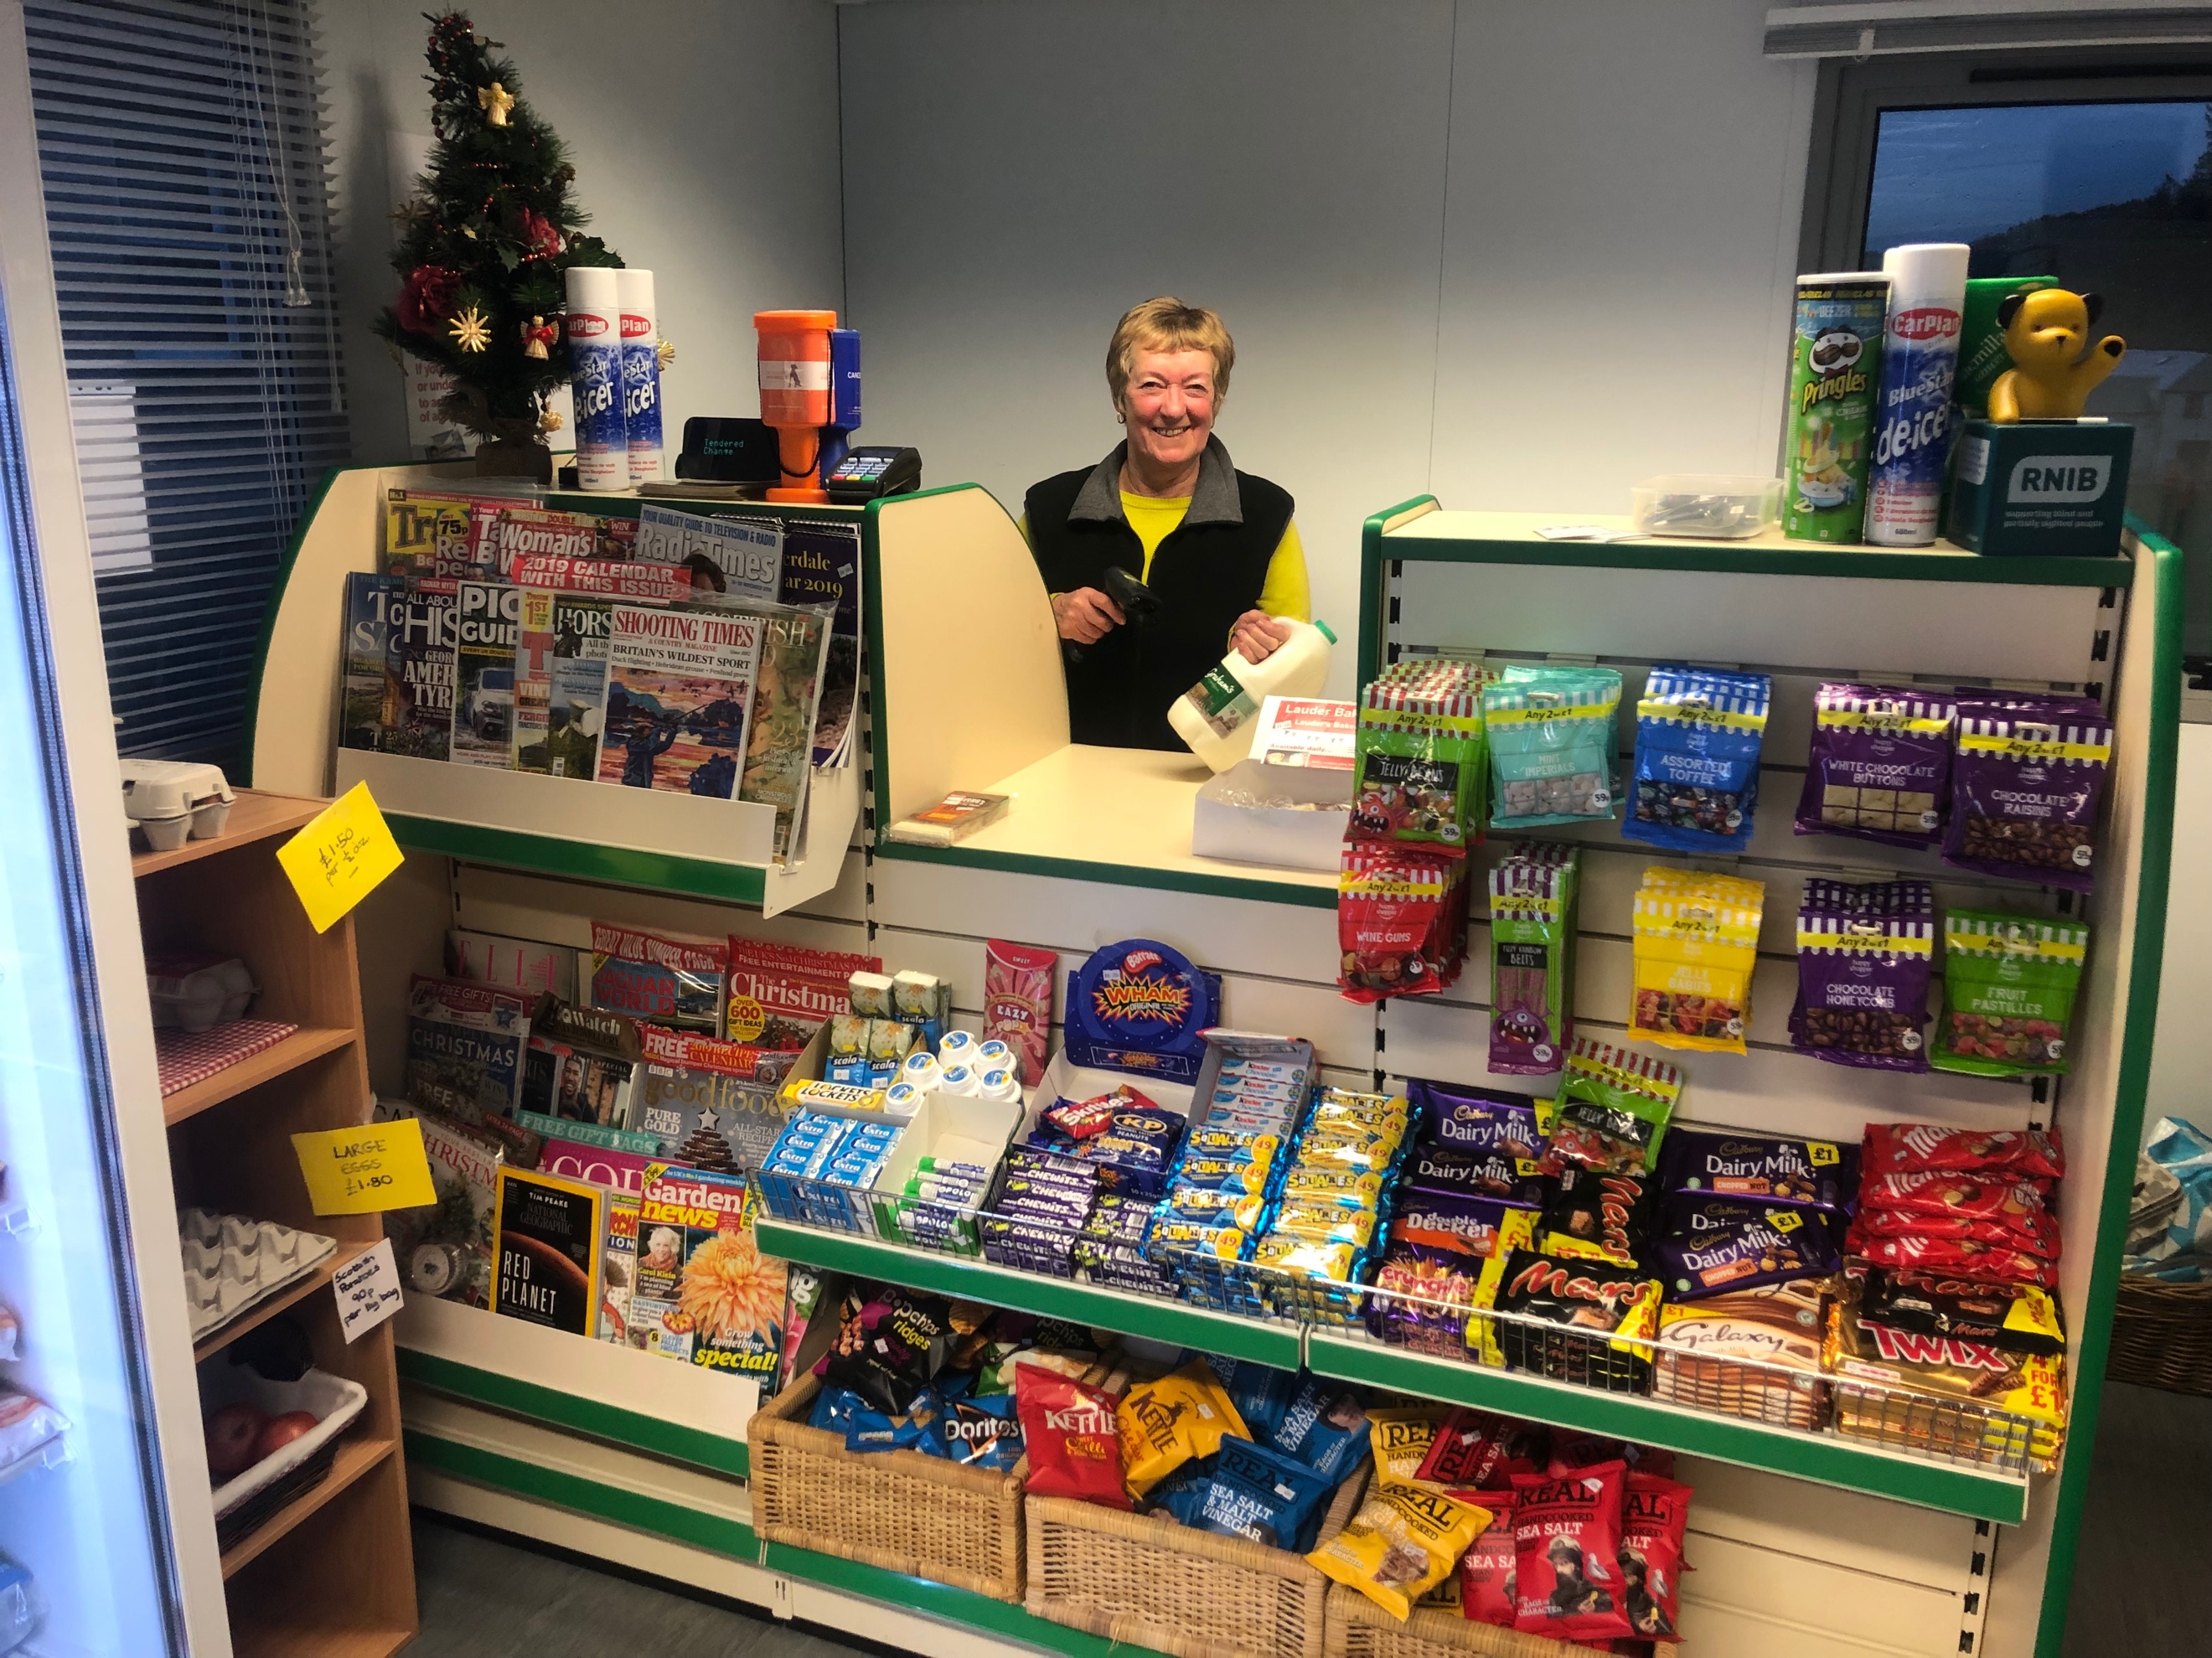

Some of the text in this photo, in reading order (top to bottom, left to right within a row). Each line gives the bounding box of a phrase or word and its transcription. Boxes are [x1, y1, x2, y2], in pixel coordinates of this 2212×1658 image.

[1801, 370, 1868, 416] Pringles
[705, 439, 744, 447] Tendered
[2021, 467, 2098, 493] RNIB
[440, 519, 468, 535] 75p
[547, 515, 575, 524] DOUBLE
[643, 509, 777, 547] YOUR QUALITY GUIDE TO TELEVISION RADIO
[500, 522, 591, 556] Woman's
[522, 558, 674, 583] 2019 CALENDAR
[520, 571, 674, 598] WITH THIS ISSUE
[804, 581, 844, 601] 2019
[406, 593, 425, 605] ALL
[614, 610, 701, 643] SHOOTING
[704, 620, 755, 648] TIMES
[654, 639, 718, 653] COUNTRY MAGAZINE
[612, 644, 752, 669] BRITAIN'S WILDEST SPORT
[1204, 668, 1235, 695] Graham's
[1285, 704, 1331, 717] Lauder
[1524, 710, 1553, 721] Any 2
[1295, 718, 1331, 728] Lauder's
[1396, 713, 1427, 726] Any 2
[1538, 754, 1560, 765] MINT
[1660, 754, 1732, 777] ASSORTED
[1380, 762, 1408, 777] JELLY
[1524, 762, 1576, 777] IMPERIALS
[1668, 767, 1715, 785] TOFFEE
[1828, 760, 1936, 778] WHITE CHOCOLATE
[1853, 772, 1907, 788] BUTTONS
[1594, 793, 1610, 803] 59p
[1991, 790, 2068, 808] CHOCOLATE
[2003, 801, 2052, 817] RAISINS
[1444, 826, 1460, 838] 59p
[319, 827, 354, 869] £1.50
[1367, 882, 1386, 893] Any
[1356, 930, 1411, 943] WINE GUMS
[1836, 937, 1862, 948] Any
[595, 927, 716, 970] GREAT VALUE BUMPER PACK
[739, 953, 841, 979] FREE ENTERTAINMENT
[793, 956, 850, 971] CHRISTMAS
[1128, 951, 1160, 967] Barratt
[1510, 953, 1535, 967] BELTS
[760, 974, 776, 986] The
[1667, 978, 1712, 994] BABIES
[1106, 987, 1181, 1005] WHAM
[1826, 984, 1896, 998] CHOCOLATE
[1987, 986, 2029, 1004] FRUIT
[736, 999, 754, 1007] OVER
[1825, 994, 1896, 1009] HONEYCOMB
[1972, 999, 2044, 1015] PASTILLES
[730, 1005, 761, 1020] 600
[902, 1015, 925, 1024] scala
[997, 1005, 1029, 1020] EAZY
[743, 1019, 762, 1027] IDEAS
[996, 1019, 1019, 1032] POP
[412, 1028, 515, 1067] CHRISTMAS
[645, 1032, 690, 1060] FREE
[681, 1059, 703, 1068] bumper
[703, 1062, 732, 1073] Christmas
[832, 1055, 858, 1065] scala
[871, 1061, 897, 1070] scala
[1248, 1062, 1271, 1072] kinder
[648, 1064, 674, 1077] BBC
[1243, 1080, 1267, 1089] kinder
[800, 1087, 858, 1103] LOCKETS
[1239, 1097, 1262, 1107] kinder
[645, 1107, 682, 1123] PURE
[1234, 1114, 1258, 1124] kinder
[1454, 1104, 1495, 1122] Cadbury
[523, 1115, 609, 1145] FREE GIFT
[643, 1118, 680, 1135] GOLD
[797, 1121, 824, 1134] Extra
[1122, 1116, 1160, 1130] KP
[1116, 1130, 1150, 1141] PEANUTS
[1441, 1118, 1535, 1146] Dairy Milk
[333, 1139, 387, 1160] LARGE
[1719, 1140, 1765, 1156] Cadbury
[1813, 1146, 1834, 1162] £1
[340, 1158, 382, 1175] EGGS
[1418, 1159, 1469, 1179] Dairy
[1706, 1154, 1808, 1179] Dairy Milk
[345, 1174, 394, 1197] £1.80
[698, 1175, 726, 1186] gardening
[1716, 1180, 1768, 1192] CHOPPED NUT
[529, 1191, 569, 1208] TIM PEAKE
[645, 1179, 742, 1214] Garden
[527, 1202, 569, 1223] NATIONAL
[643, 1201, 719, 1228] news
[1427, 1211, 1478, 1226] double
[1600, 1175, 1643, 1263] Mars
[1407, 1213, 1495, 1238] Decker
[1689, 1230, 1731, 1251] Cadbury
[1682, 1230, 1783, 1271] Dairy Milk
[334, 1254, 375, 1284] Scottish
[504, 1250, 530, 1281] RED
[1734, 1262, 1754, 1274] NUT
[1508, 1260, 1652, 1305] Mars
[351, 1287, 375, 1303] 90p
[502, 1276, 557, 1315] PLANET
[344, 1287, 400, 1328] per bag
[650, 1332, 659, 1342] 8
[725, 1327, 754, 1340] Grow
[892, 1319, 932, 1351] ridges
[1667, 1321, 1785, 1354] Galaxy
[1952, 1323, 1998, 1339] Mars
[710, 1336, 764, 1352] something
[1858, 1319, 2010, 1372] TWIX
[694, 1347, 778, 1372] special!
[1044, 1408, 1119, 1436] KETTLE
[1129, 1389, 1180, 1456] KETTLE
[1288, 1397, 1315, 1435] MALT
[1288, 1394, 1331, 1453] VINEGAR
[943, 1418, 1020, 1442] Doritos
[1209, 1483, 1274, 1521] SEA SALT
[1517, 1480, 1596, 1508] REAL
[1207, 1496, 1258, 1524] & MALT
[1202, 1505, 1262, 1542] VINEGAR
[1517, 1521, 1584, 1541] SEA SALT
[1465, 1555, 1496, 1569] SEA
